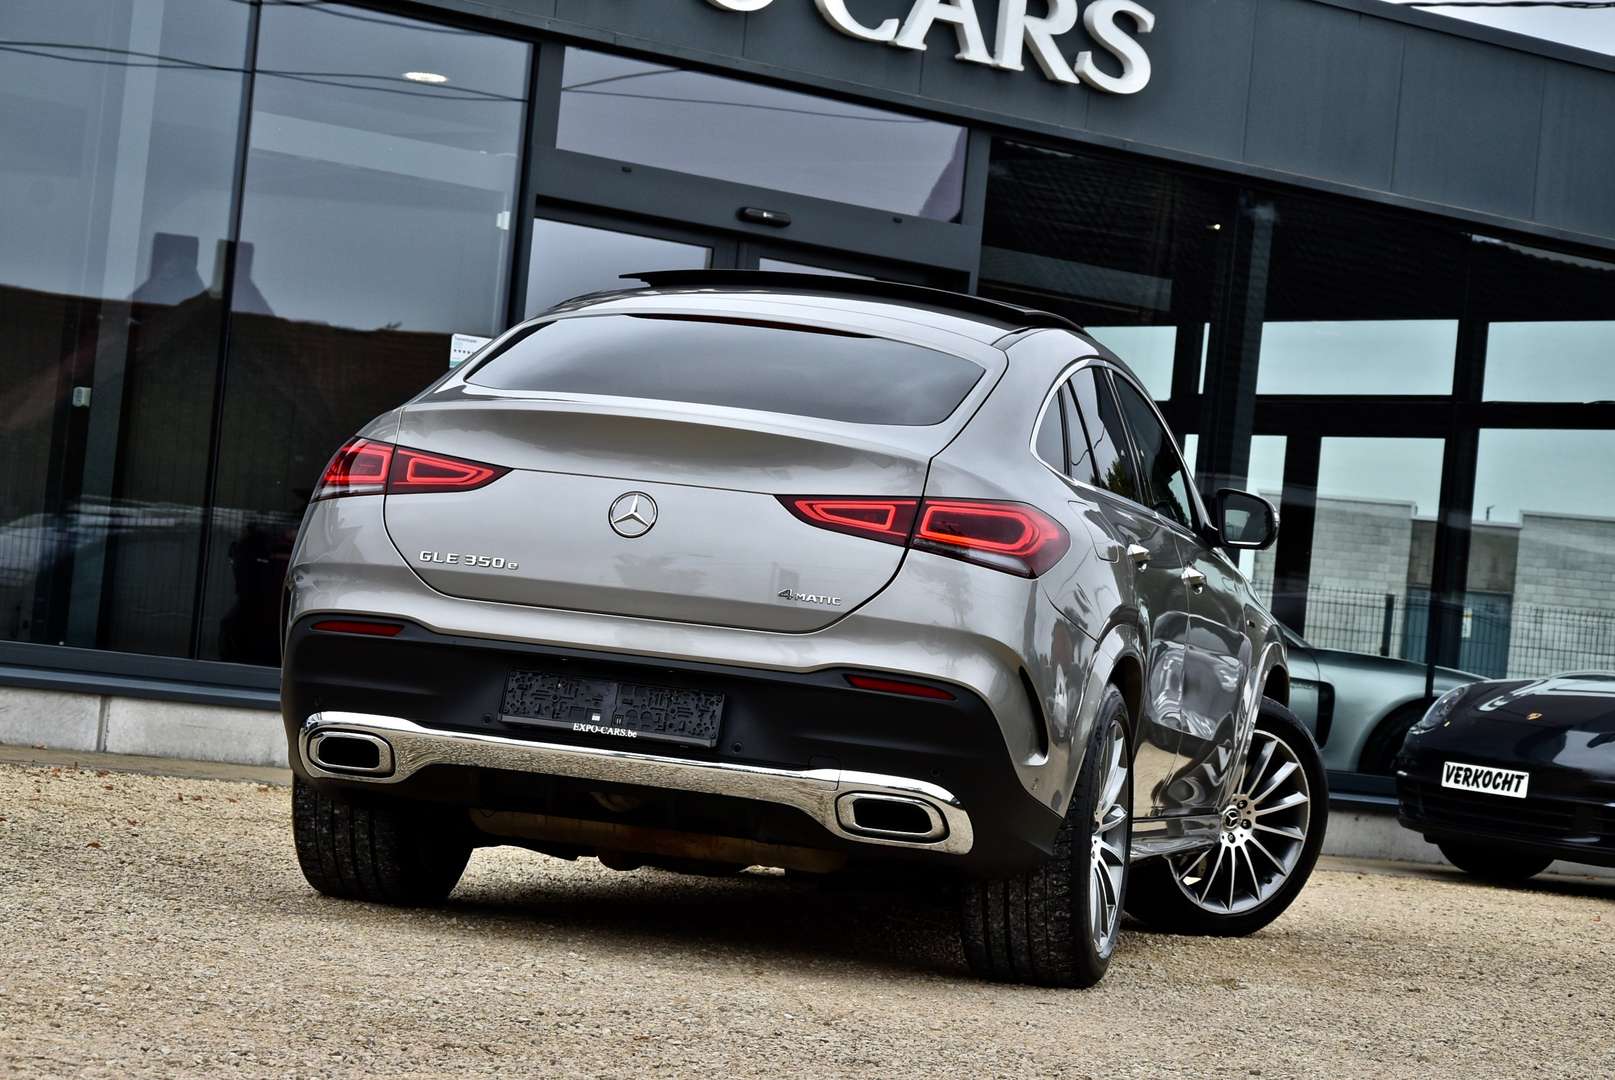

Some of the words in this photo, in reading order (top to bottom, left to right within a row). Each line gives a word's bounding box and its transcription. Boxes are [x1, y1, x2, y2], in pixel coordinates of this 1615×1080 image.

[419, 550, 459, 564] GLE
[573, 722, 638, 738] EXPO-CARS.be
[1445, 764, 1525, 793] VERKOCHT
